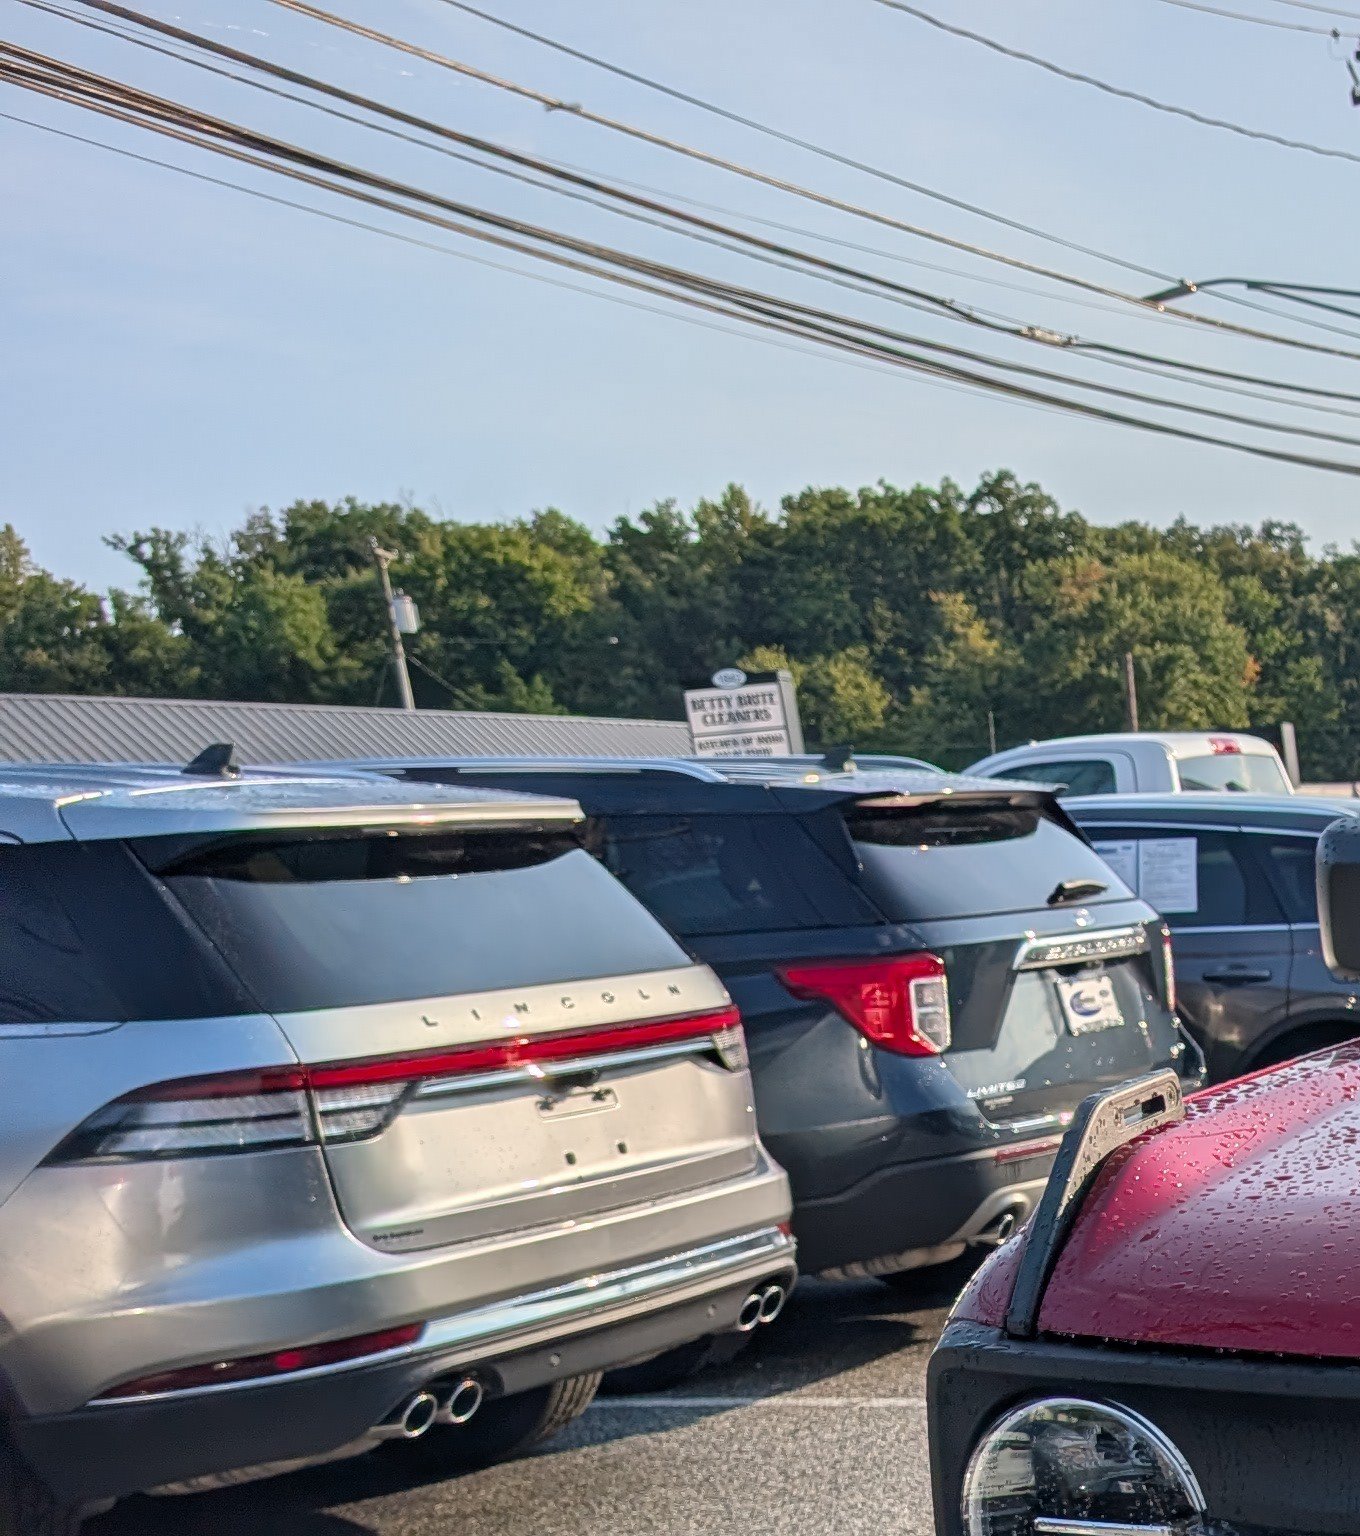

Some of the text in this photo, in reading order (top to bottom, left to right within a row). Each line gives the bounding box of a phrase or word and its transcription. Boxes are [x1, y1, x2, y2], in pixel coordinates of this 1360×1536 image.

[691, 696, 732, 712] BETTY
[702, 708, 772, 726] CLEANERS
[421, 984, 680, 1028] LINCOLN
